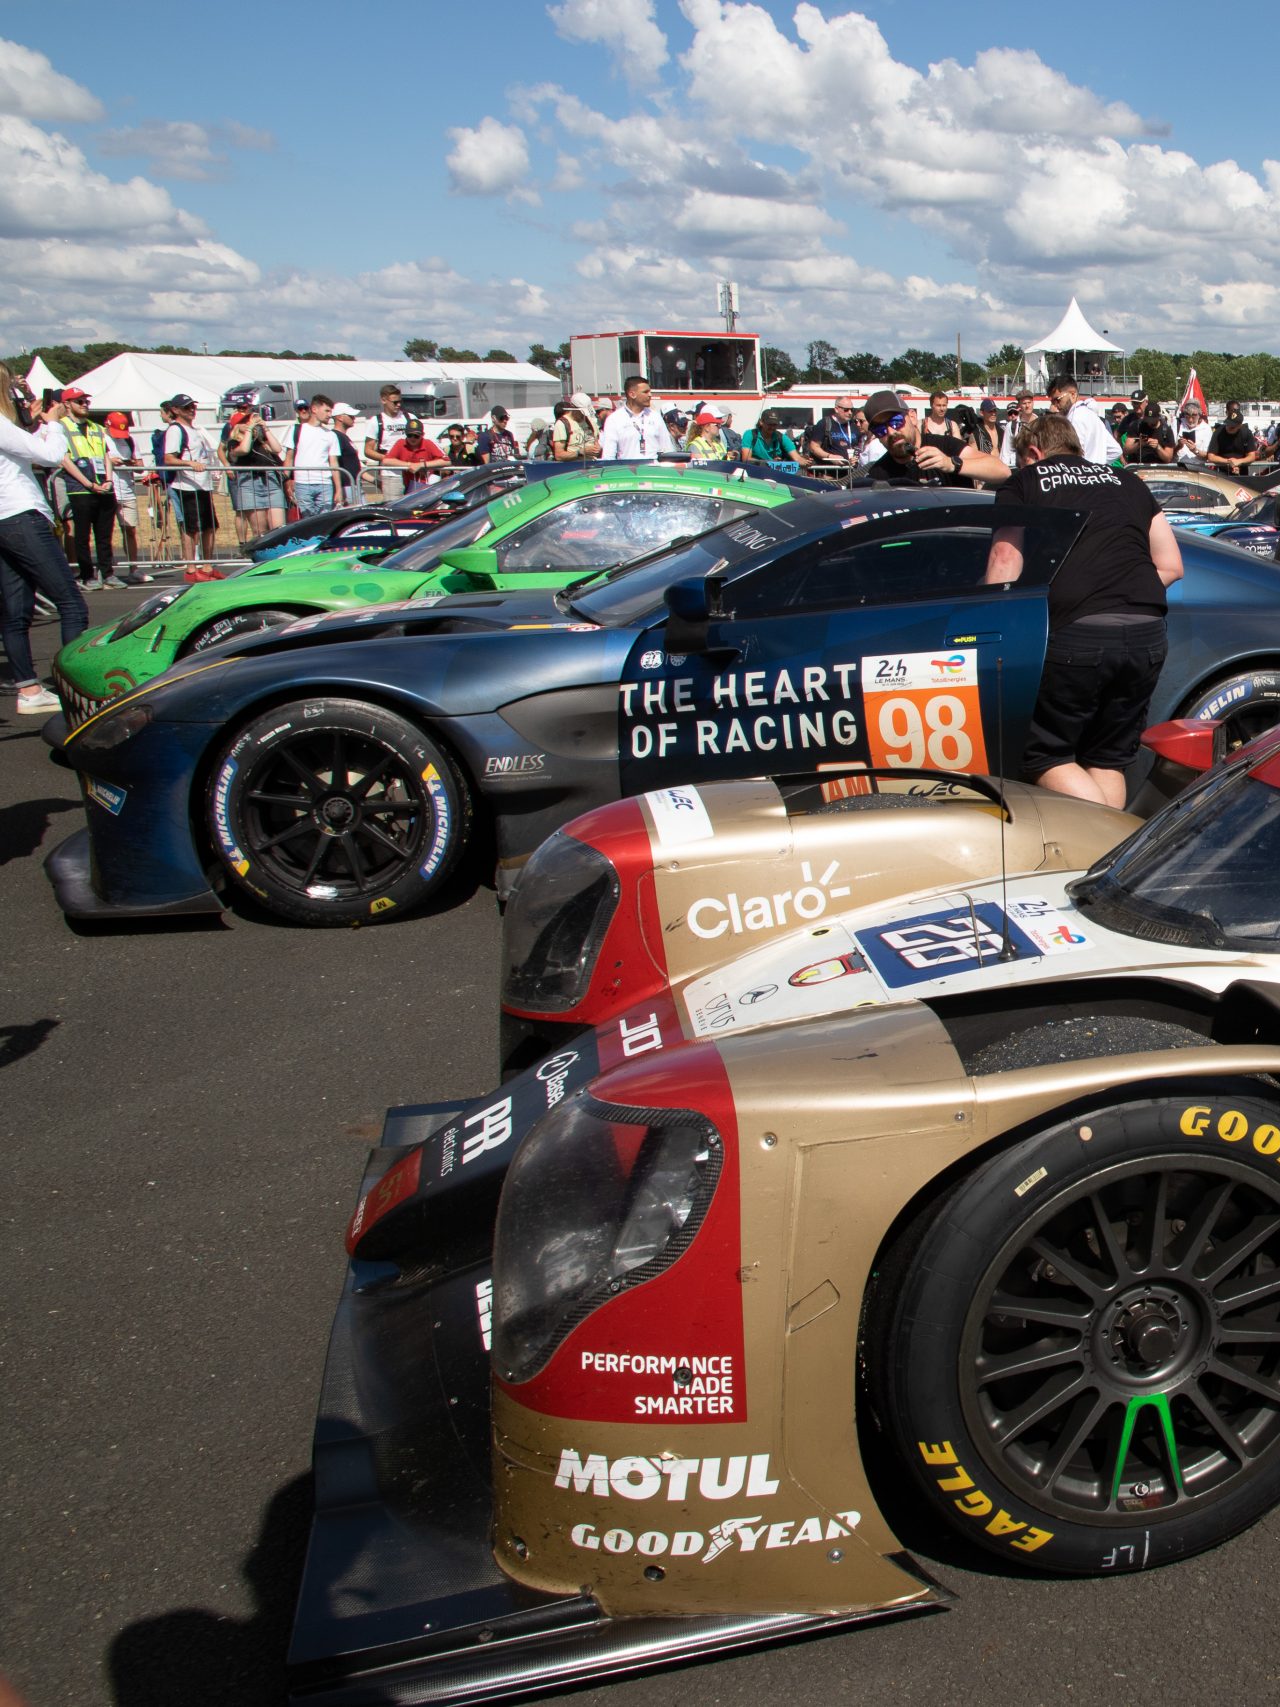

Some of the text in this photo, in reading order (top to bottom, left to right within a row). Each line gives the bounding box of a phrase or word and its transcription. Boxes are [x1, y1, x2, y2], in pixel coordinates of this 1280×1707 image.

[1040, 473, 1122, 492] CAMERAS
[619, 662, 857, 718] THE HEART
[631, 709, 858, 760] OF RACING
[878, 694, 973, 770] 98
[485, 753, 546, 773] ENDLESS
[217, 762, 236, 848] MICHELIN
[423, 794, 451, 874] MICHELIN
[687, 884, 827, 940] Claro
[440, 1126, 460, 1177] electronics
[462, 1095, 512, 1165] PR
[581, 1351, 733, 1376] PERFORMANCE
[673, 1375, 734, 1396] MADE
[633, 1395, 734, 1416] SMARTER
[553, 1449, 780, 1501] MOTUL
[918, 1439, 1055, 1553] EAGLE
